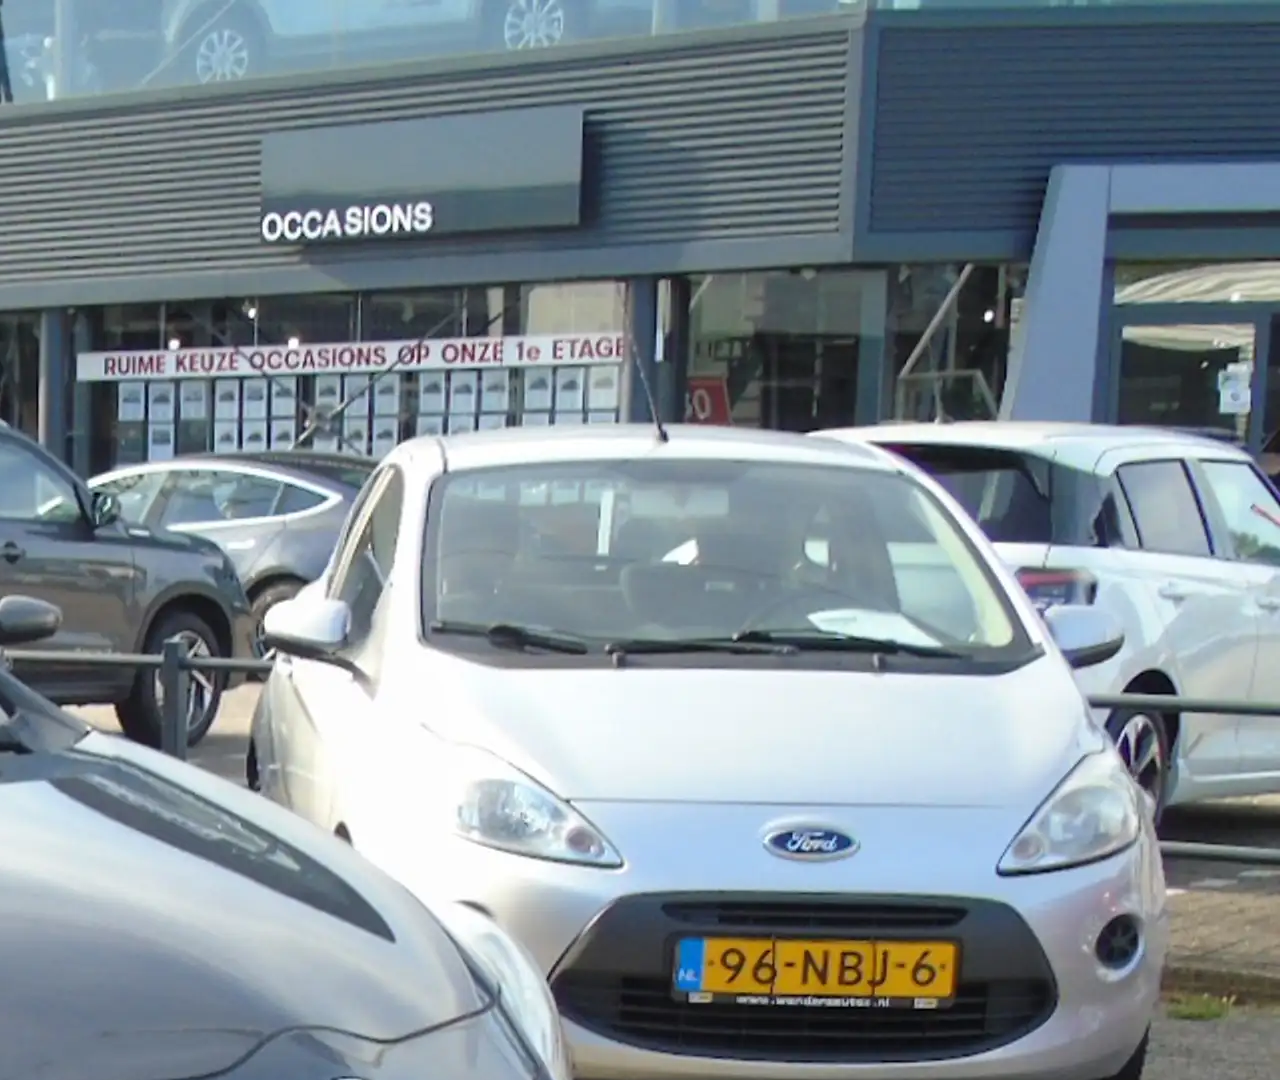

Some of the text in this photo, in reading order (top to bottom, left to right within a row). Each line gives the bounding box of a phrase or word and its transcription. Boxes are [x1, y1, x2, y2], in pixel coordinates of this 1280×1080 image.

[261, 201, 433, 242] OCCASIONS
[104, 336, 624, 376] RUIME KEUZE OCCASIONS OP ONZE 1e ETAGE
[786, 831, 838, 852] Ford
[678, 947, 937, 987] NL 96-NBJ-6
